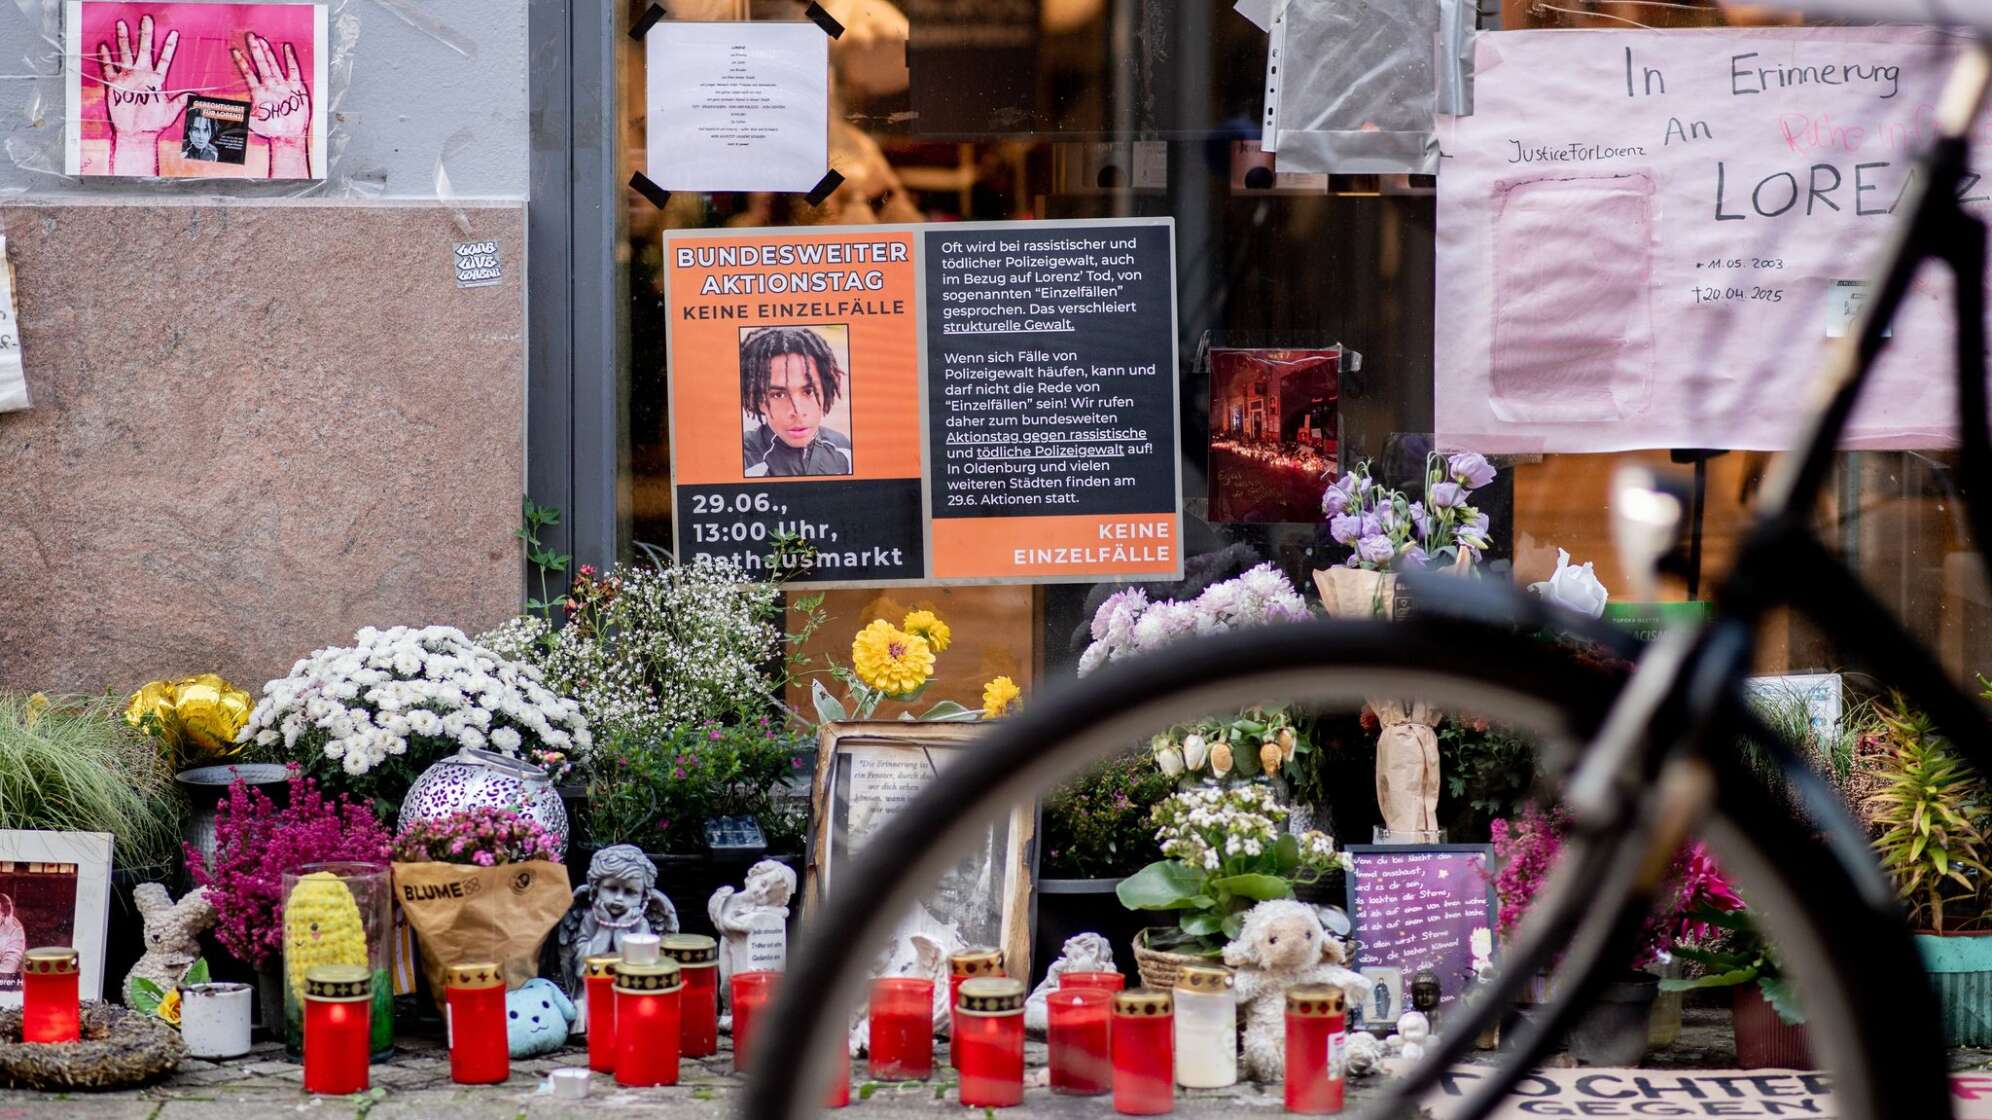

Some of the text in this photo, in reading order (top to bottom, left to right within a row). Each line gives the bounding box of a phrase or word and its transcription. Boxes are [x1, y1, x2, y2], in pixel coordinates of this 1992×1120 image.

[1625, 46, 1899, 98] In Erinnerung
[1664, 117, 1712, 147] An
[942, 238, 1136, 253] Oft wird bei rassistischer und
[676, 241, 909, 268] BUNDESWEITER
[942, 254, 1134, 269] tödlicher Polizeigewalt, auch
[1752, 258, 1783, 269] 2003
[700, 270, 884, 295] AKTIONSTAG
[943, 274, 959, 285] im
[964, 273, 1006, 285] Bezug
[1010, 272, 1031, 283] auf
[1087, 270, 1114, 282] Tod,
[1118, 271, 1142, 280] von
[943, 289, 1031, 302] sogenannten
[1751, 286, 1783, 302] 2025
[684, 298, 904, 320] KEINE EINZELFÄLLE
[944, 302, 1136, 318] gesprochen. Das verschleiert
[944, 319, 1074, 332] strukturelle Gewalt.
[945, 350, 1077, 363] Wenn sich Fälle von
[945, 364, 1155, 380] Polizeigewalt häufen, kann und
[945, 382, 1100, 395] darf nicht die Rede von
[1036, 397, 1067, 409] sein!
[1071, 397, 1094, 408] Wir
[1099, 396, 1134, 407] rufen
[946, 413, 1118, 427] daher zum bundesweiten
[946, 428, 1147, 444] Aktionstag gegen rassistische
[947, 444, 1152, 458] und tödliche Polizeigewalt auf!
[948, 460, 1110, 475] In Oldenburg und vielen
[947, 476, 1135, 490] weiteren Städten finden am
[692, 493, 787, 514] 29.06.,
[948, 493, 1079, 505] 29.6. Aktionen statt.
[693, 520, 838, 542] 13:00 Uhr,
[1100, 523, 1168, 539] KEINE
[1014, 544, 1169, 564] EINZELFÄLLE
[404, 882, 463, 900] BLUME
[1519, 1099, 1822, 1117] GEGEN
